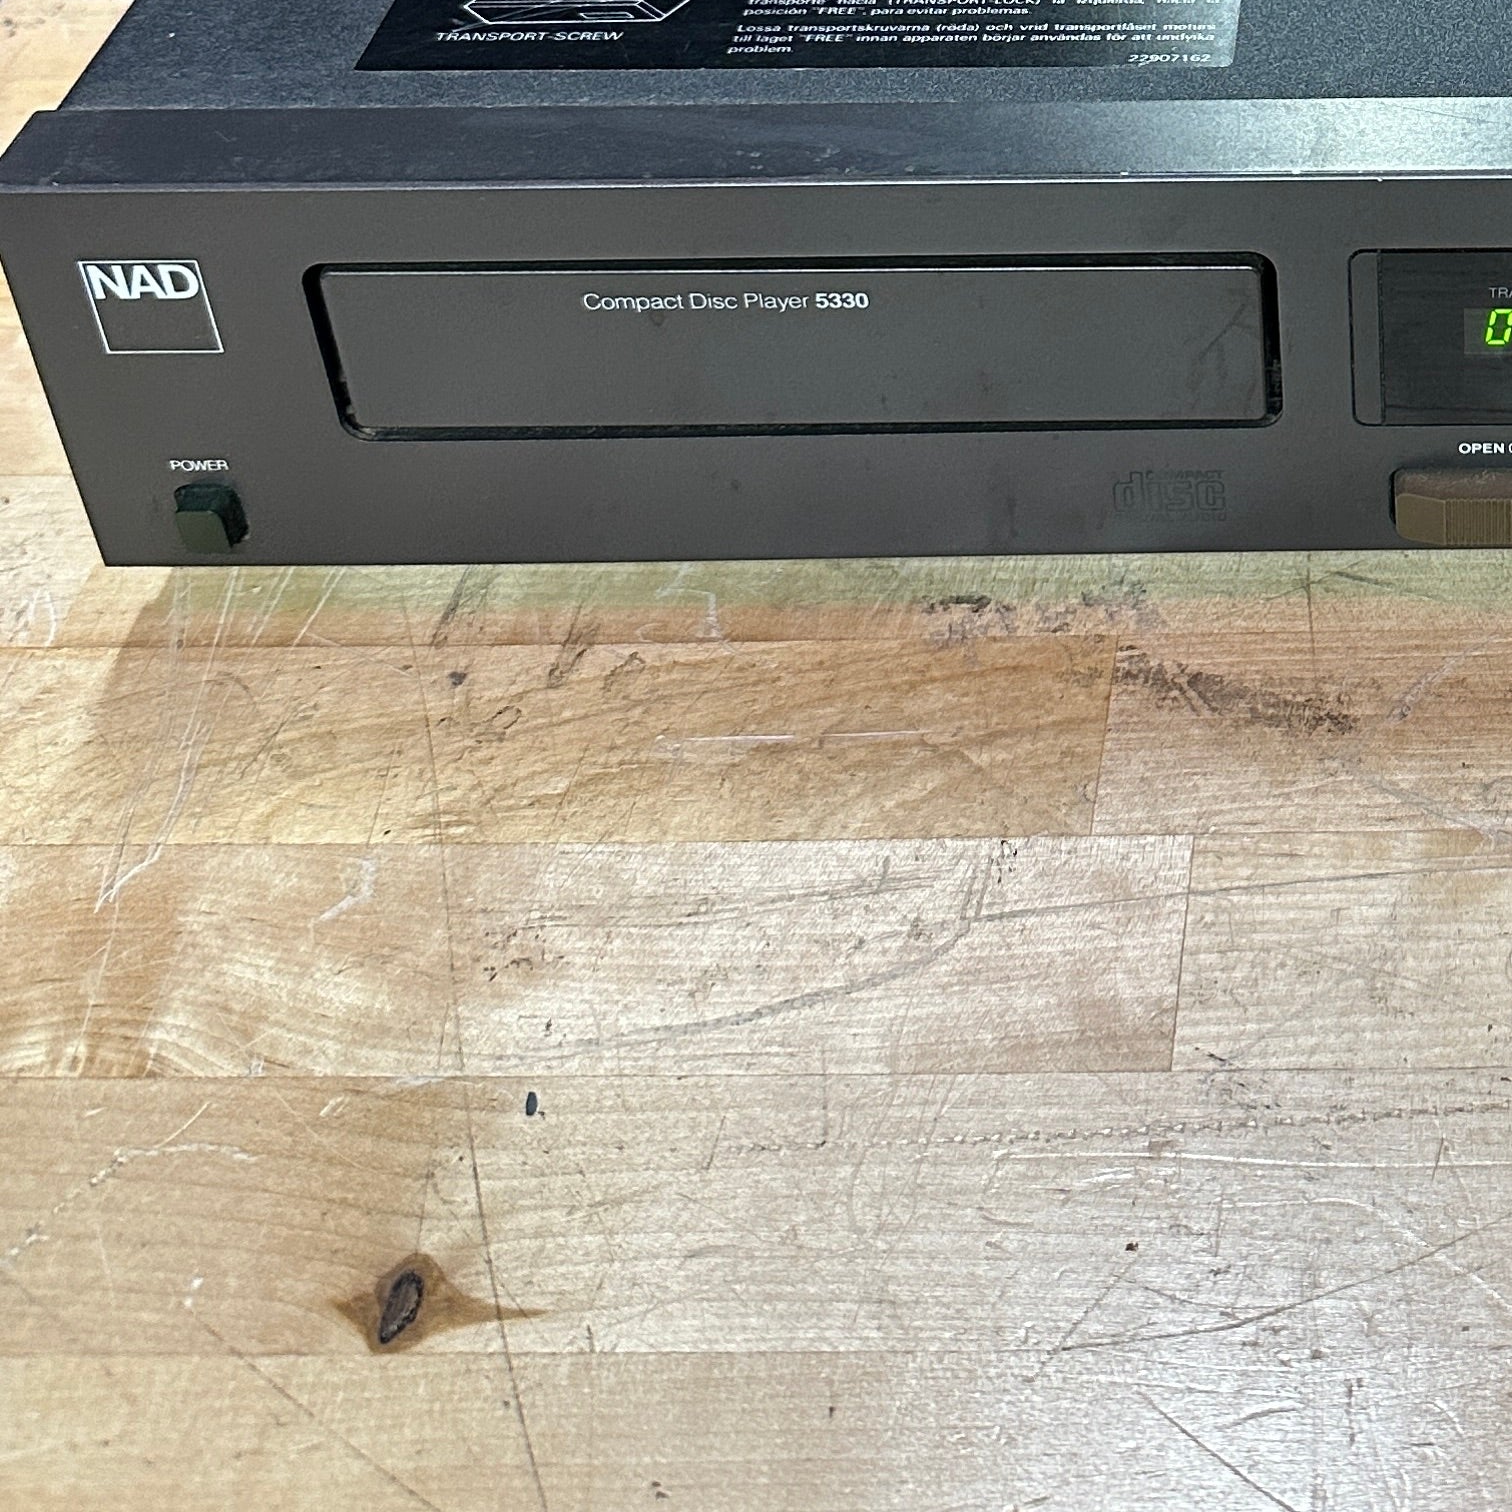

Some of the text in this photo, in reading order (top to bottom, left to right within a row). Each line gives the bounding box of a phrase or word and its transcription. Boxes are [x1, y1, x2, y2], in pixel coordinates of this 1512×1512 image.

[737, 24, 782, 32] Lossa
[985, 24, 1014, 32] och
[436, 30, 625, 42] TRANSPORT-SCREW
[1127, 54, 1212, 63] 22907162
[86, 263, 200, 299] NAD
[582, 292, 870, 313] Compact Disc Player 5330
[1458, 442, 1505, 454] OPEN
[169, 459, 230, 471] POWER
[1113, 470, 1226, 512] disc
